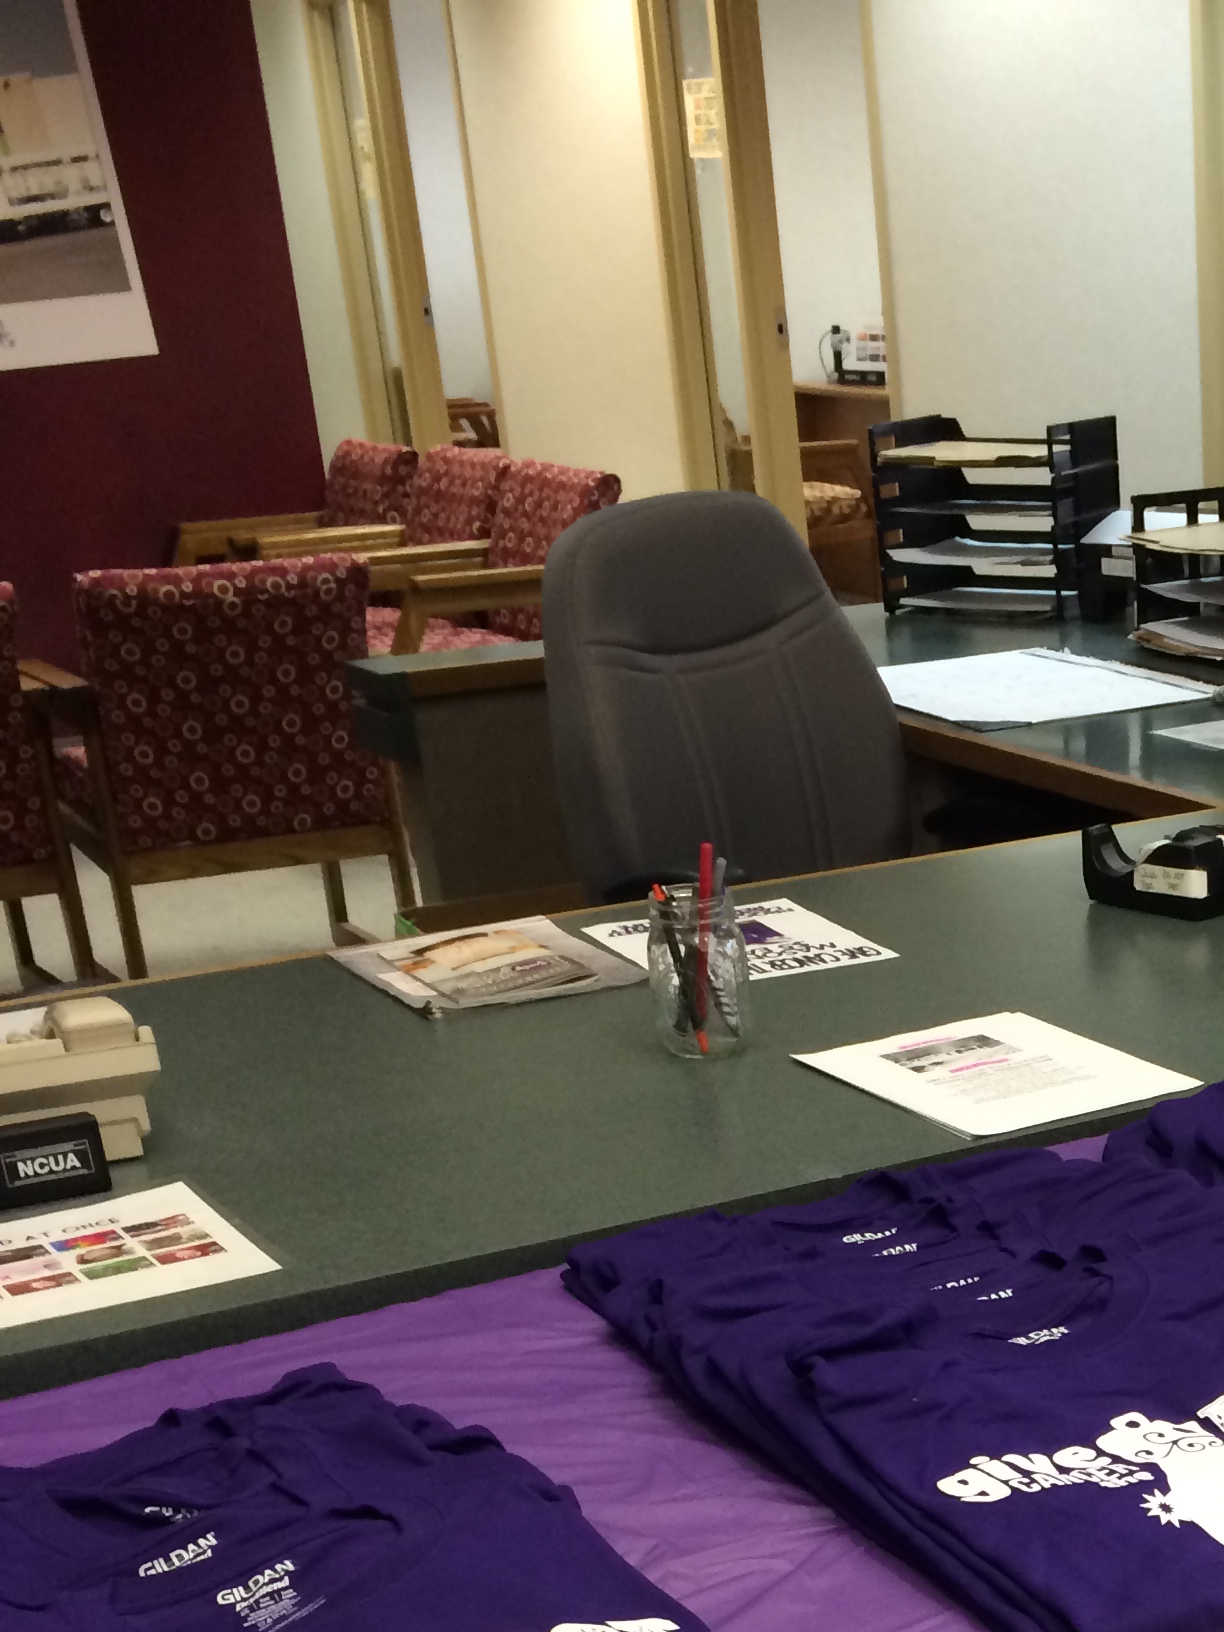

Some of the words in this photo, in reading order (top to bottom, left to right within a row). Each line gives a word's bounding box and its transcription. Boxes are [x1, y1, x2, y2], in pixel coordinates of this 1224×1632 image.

[16, 1151, 82, 1178] NCUA
[936, 1444, 1113, 1503] give
[1014, 1461, 1142, 1493] CANCER
[1098, 1468, 1156, 1489] the
[138, 1531, 218, 1577] GILDAN
[217, 1559, 296, 1605] GILDAN
